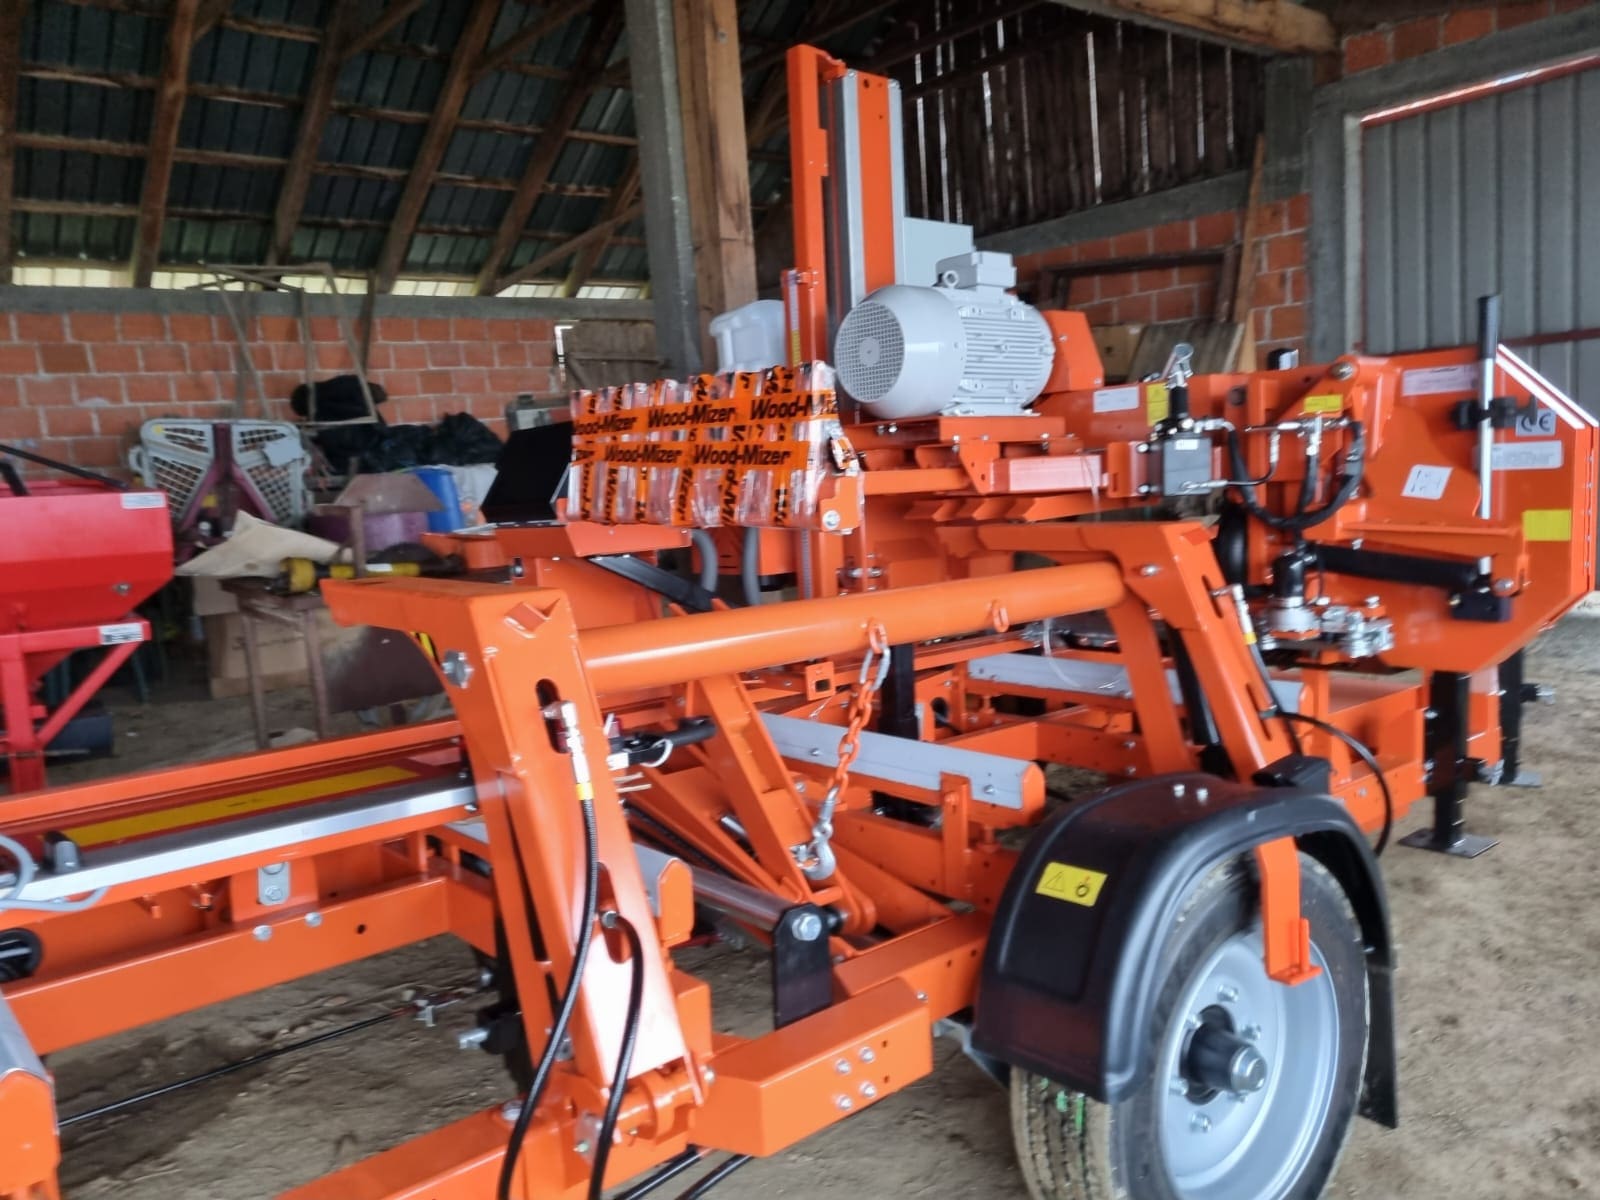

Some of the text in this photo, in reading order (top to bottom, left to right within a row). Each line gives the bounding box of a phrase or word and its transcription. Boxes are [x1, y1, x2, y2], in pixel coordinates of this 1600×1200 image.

[647, 402, 736, 429] Wood-Mizer
[1520, 411, 1552, 433] CE
[604, 444, 682, 464] Wood-Mizer
[693, 443, 791, 466] Wood-Mizer
